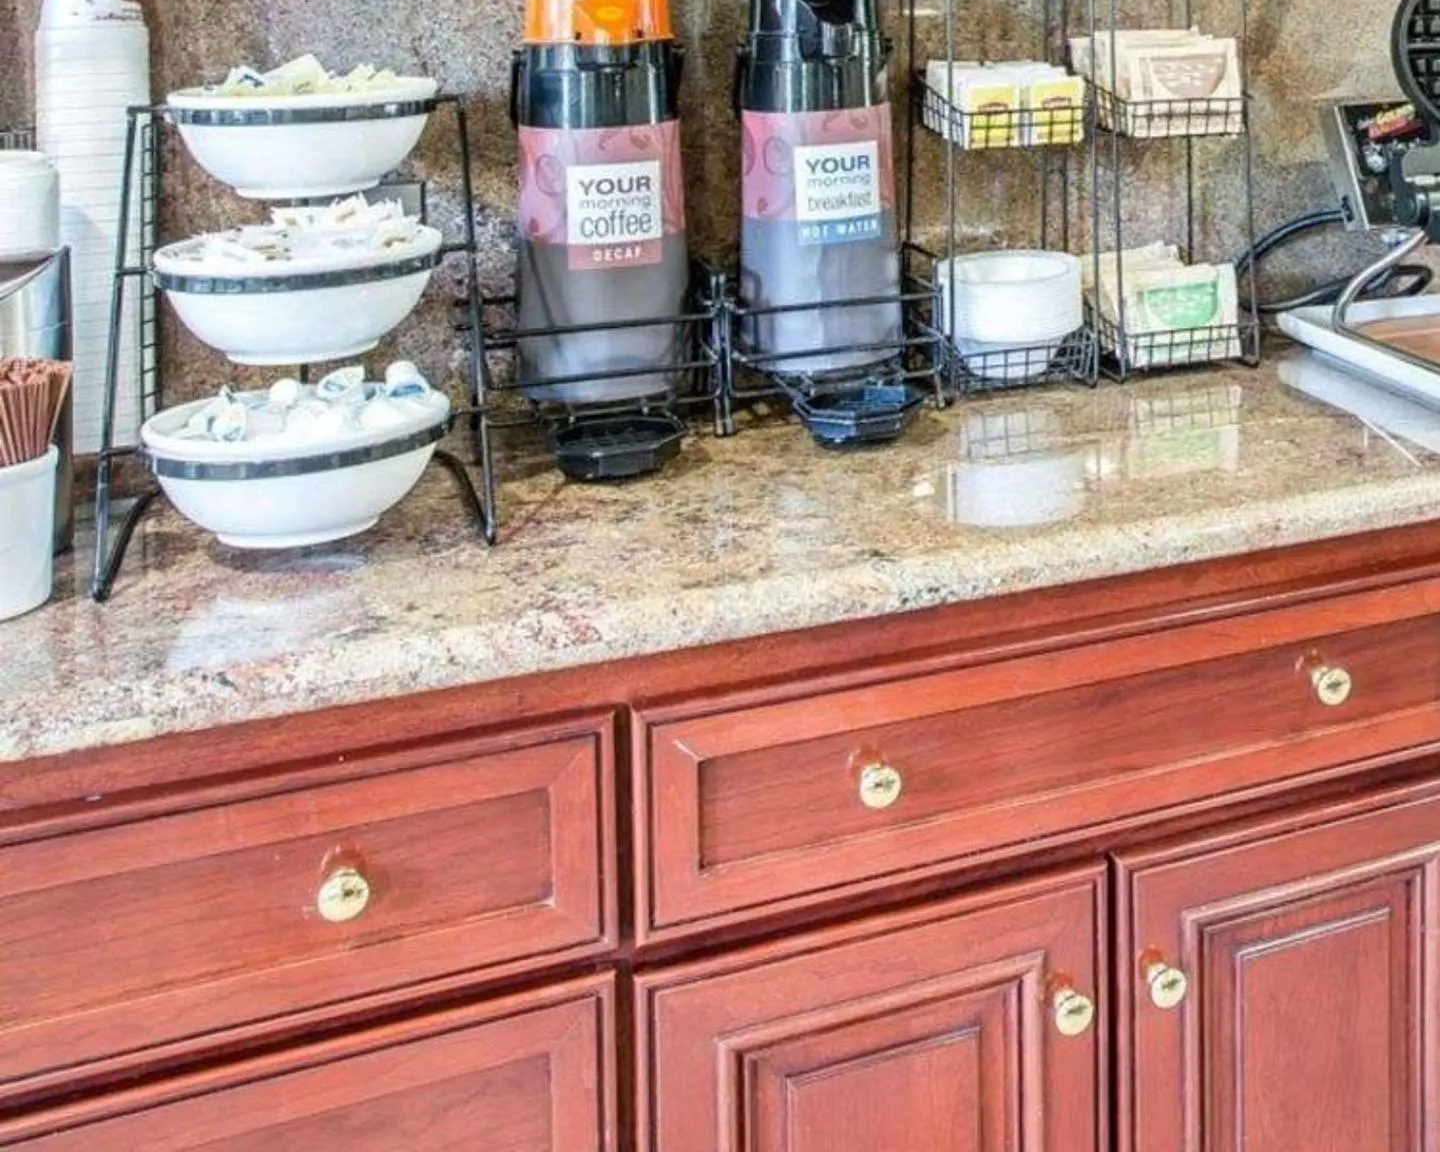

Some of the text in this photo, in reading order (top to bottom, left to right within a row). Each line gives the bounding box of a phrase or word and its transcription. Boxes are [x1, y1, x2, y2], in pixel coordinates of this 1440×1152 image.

[805, 155, 870, 175] YOUR
[578, 175, 652, 196] YOUR
[807, 173, 870, 189] morning
[579, 195, 652, 210] morning
[807, 190, 872, 212] breakfast
[580, 209, 653, 238] coffee
[835, 218, 878, 235] WATER
[592, 245, 642, 262] DECAF
